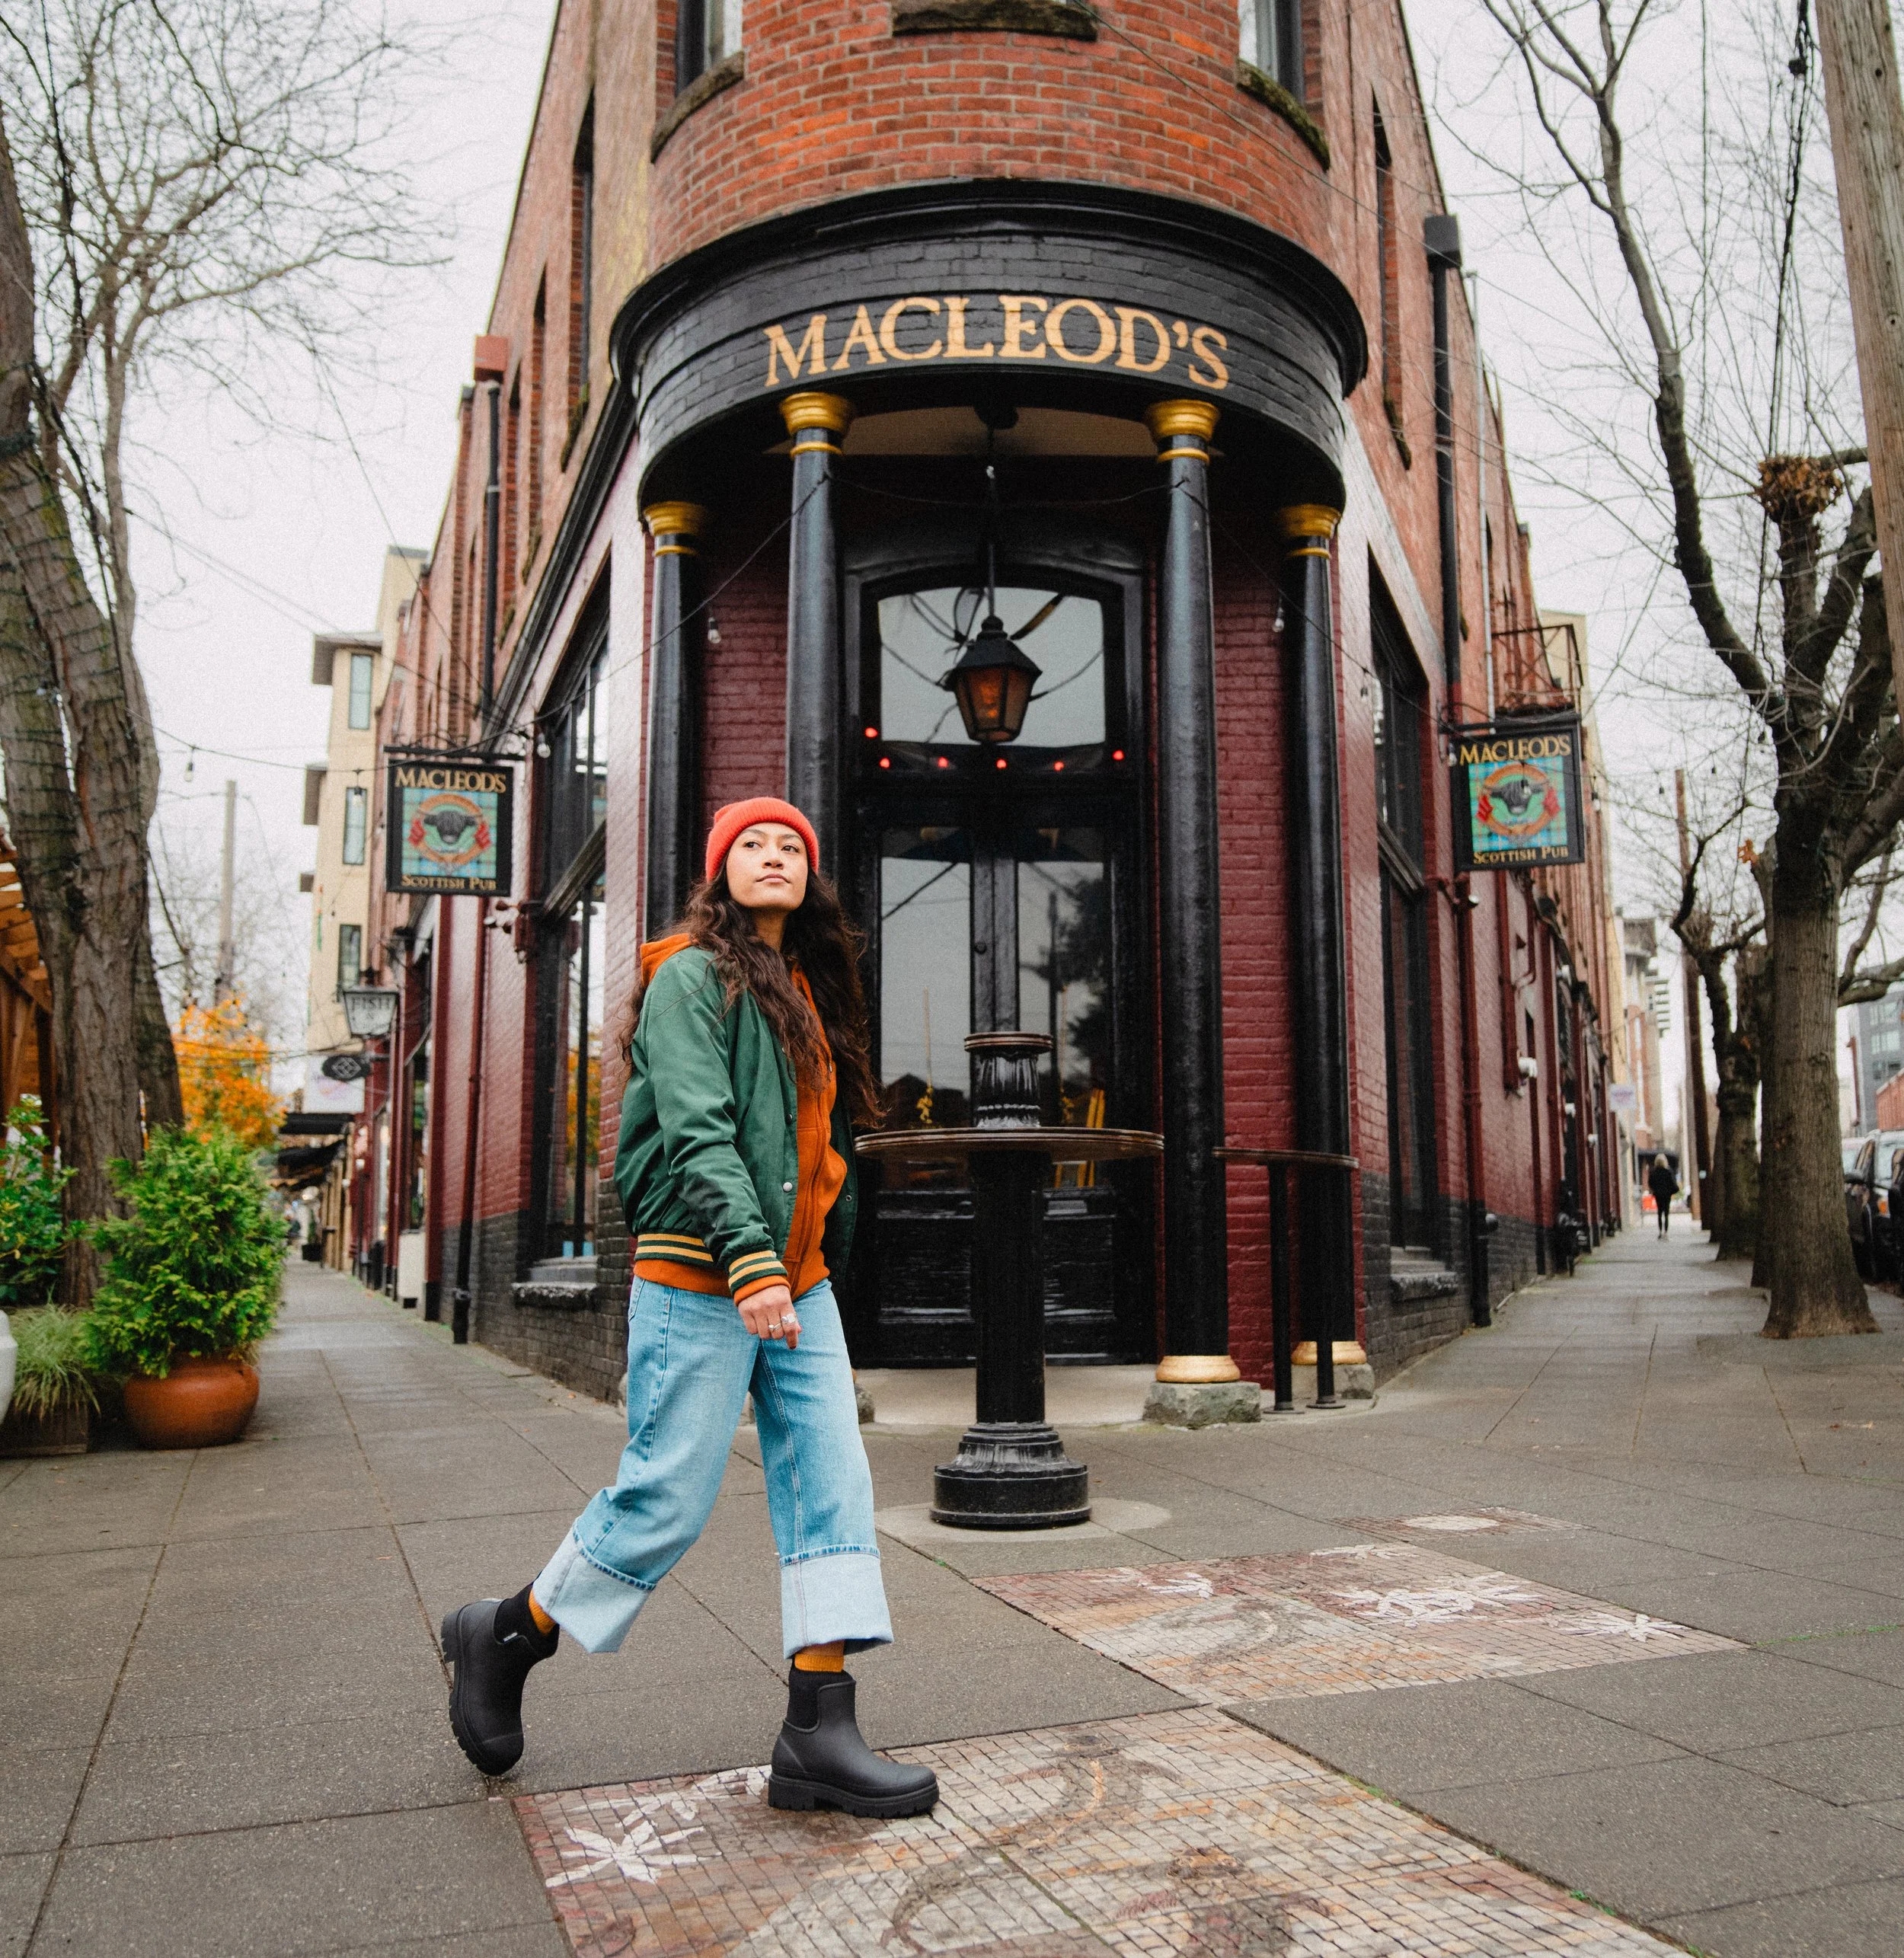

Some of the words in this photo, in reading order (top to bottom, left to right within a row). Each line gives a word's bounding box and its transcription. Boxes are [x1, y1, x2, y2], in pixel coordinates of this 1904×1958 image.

[763, 296, 1228, 390] MACLEOD'S
[1460, 735, 1571, 765] MACLEODS
[395, 768, 506, 793] MACLEODS
[1474, 850, 1536, 864] SCOTTISH
[1541, 846, 1569, 860] PUB
[401, 875, 465, 890] SCOTTISH
[469, 877, 497, 890] PUB
